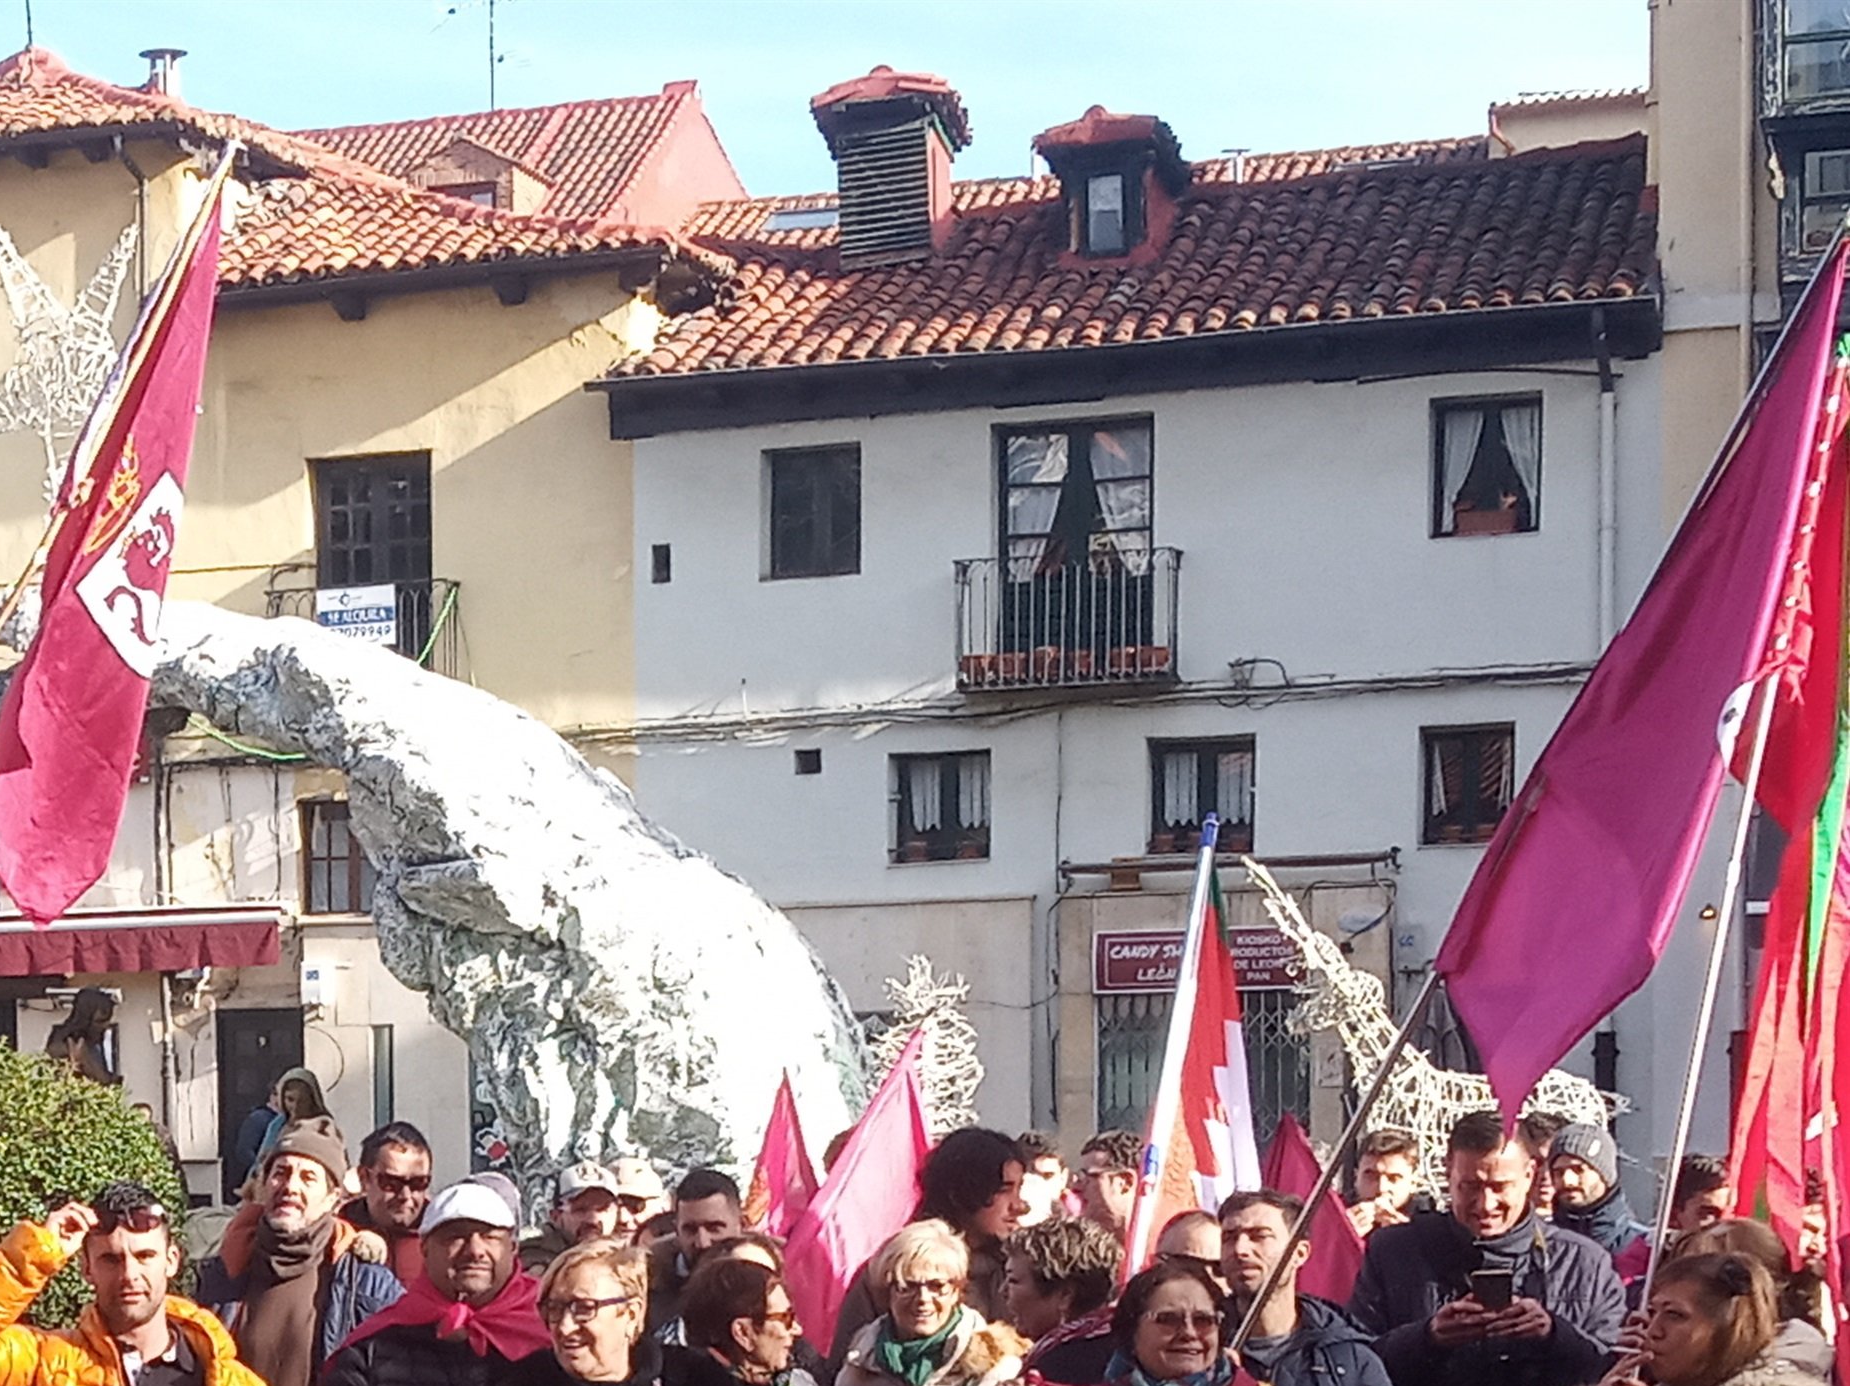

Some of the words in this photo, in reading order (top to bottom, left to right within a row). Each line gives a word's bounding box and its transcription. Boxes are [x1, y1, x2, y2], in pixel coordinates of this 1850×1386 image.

[1236, 935, 1282, 946] KIOSKO
[1110, 944, 1157, 959] CANDY
[1231, 945, 1294, 957] RODUCTOS
[1234, 959, 1250, 970] DE
[1246, 971, 1271, 981] PAN
